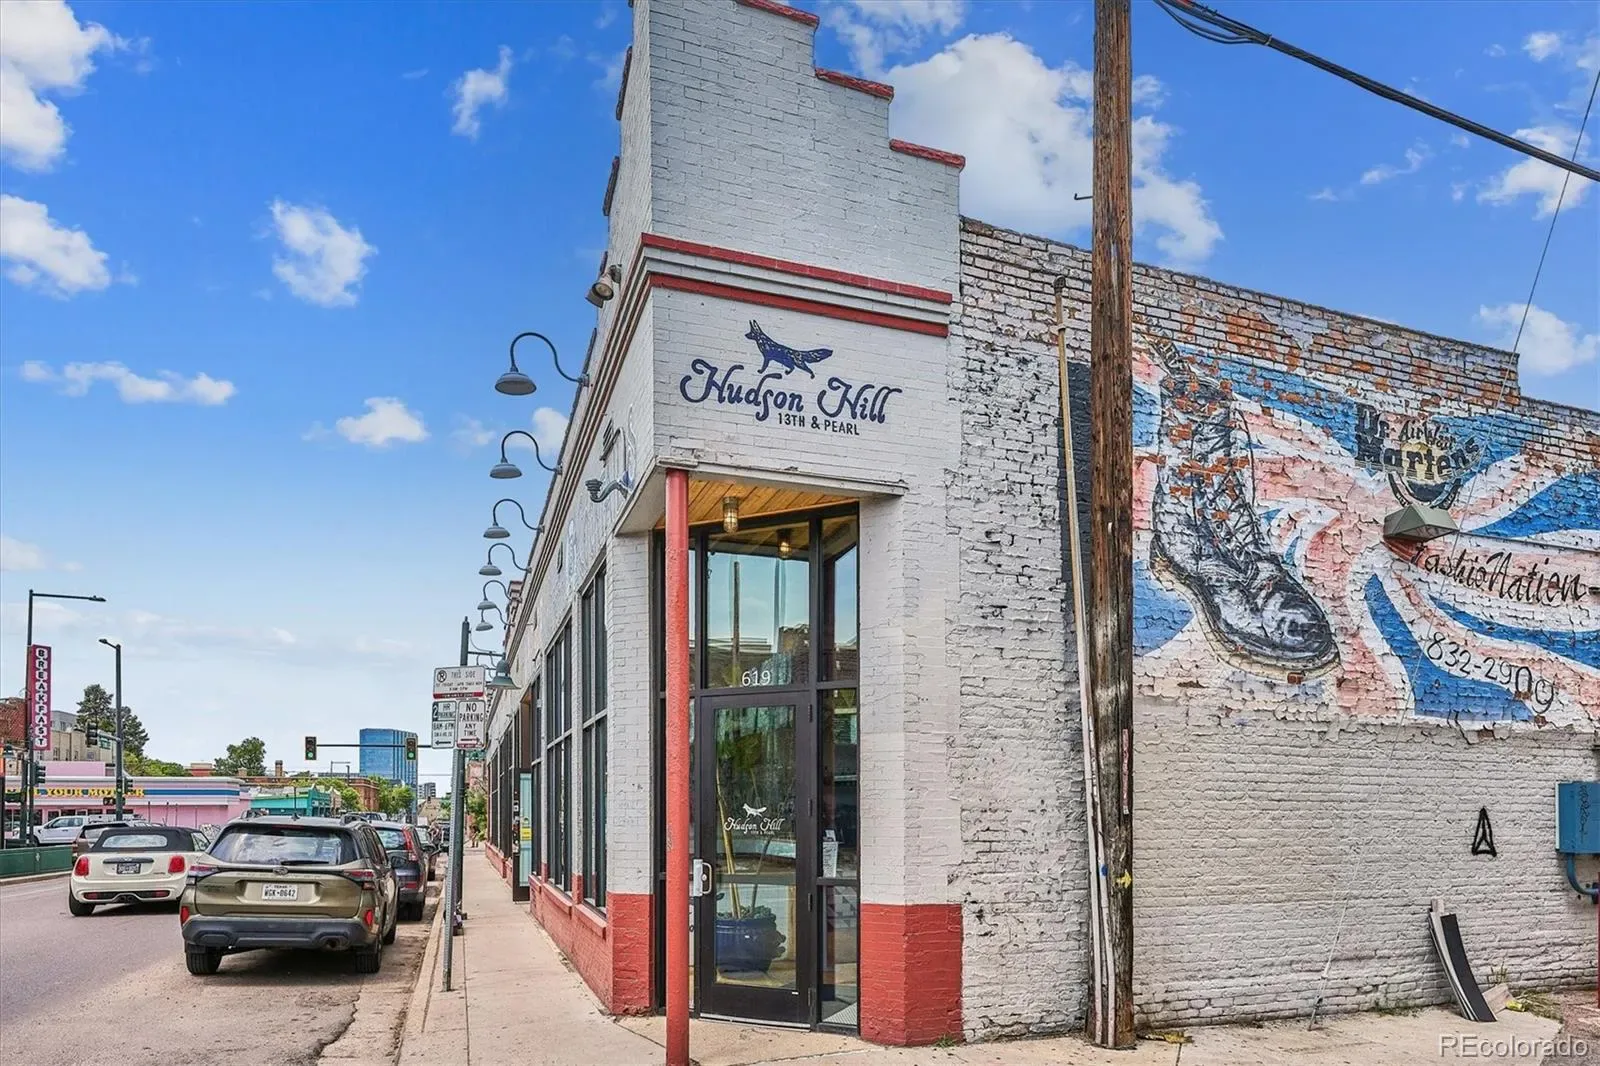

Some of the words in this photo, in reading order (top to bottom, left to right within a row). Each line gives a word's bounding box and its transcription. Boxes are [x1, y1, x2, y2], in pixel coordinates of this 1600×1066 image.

[680, 358, 803, 422] Hudson
[817, 376, 902, 424] Hill
[777, 412, 806, 428] 13TH
[810, 416, 821, 430] &
[824, 419, 860, 436] PEARL
[741, 670, 771, 687] 619
[1427, 631, 1554, 714] 832-2909
[36, 648, 47, 746] BREAKFAST
[433, 704, 439, 718] 2
[465, 702, 477, 712] NO
[459, 713, 484, 722] PARKING
[760, 817, 786, 831] Hill
